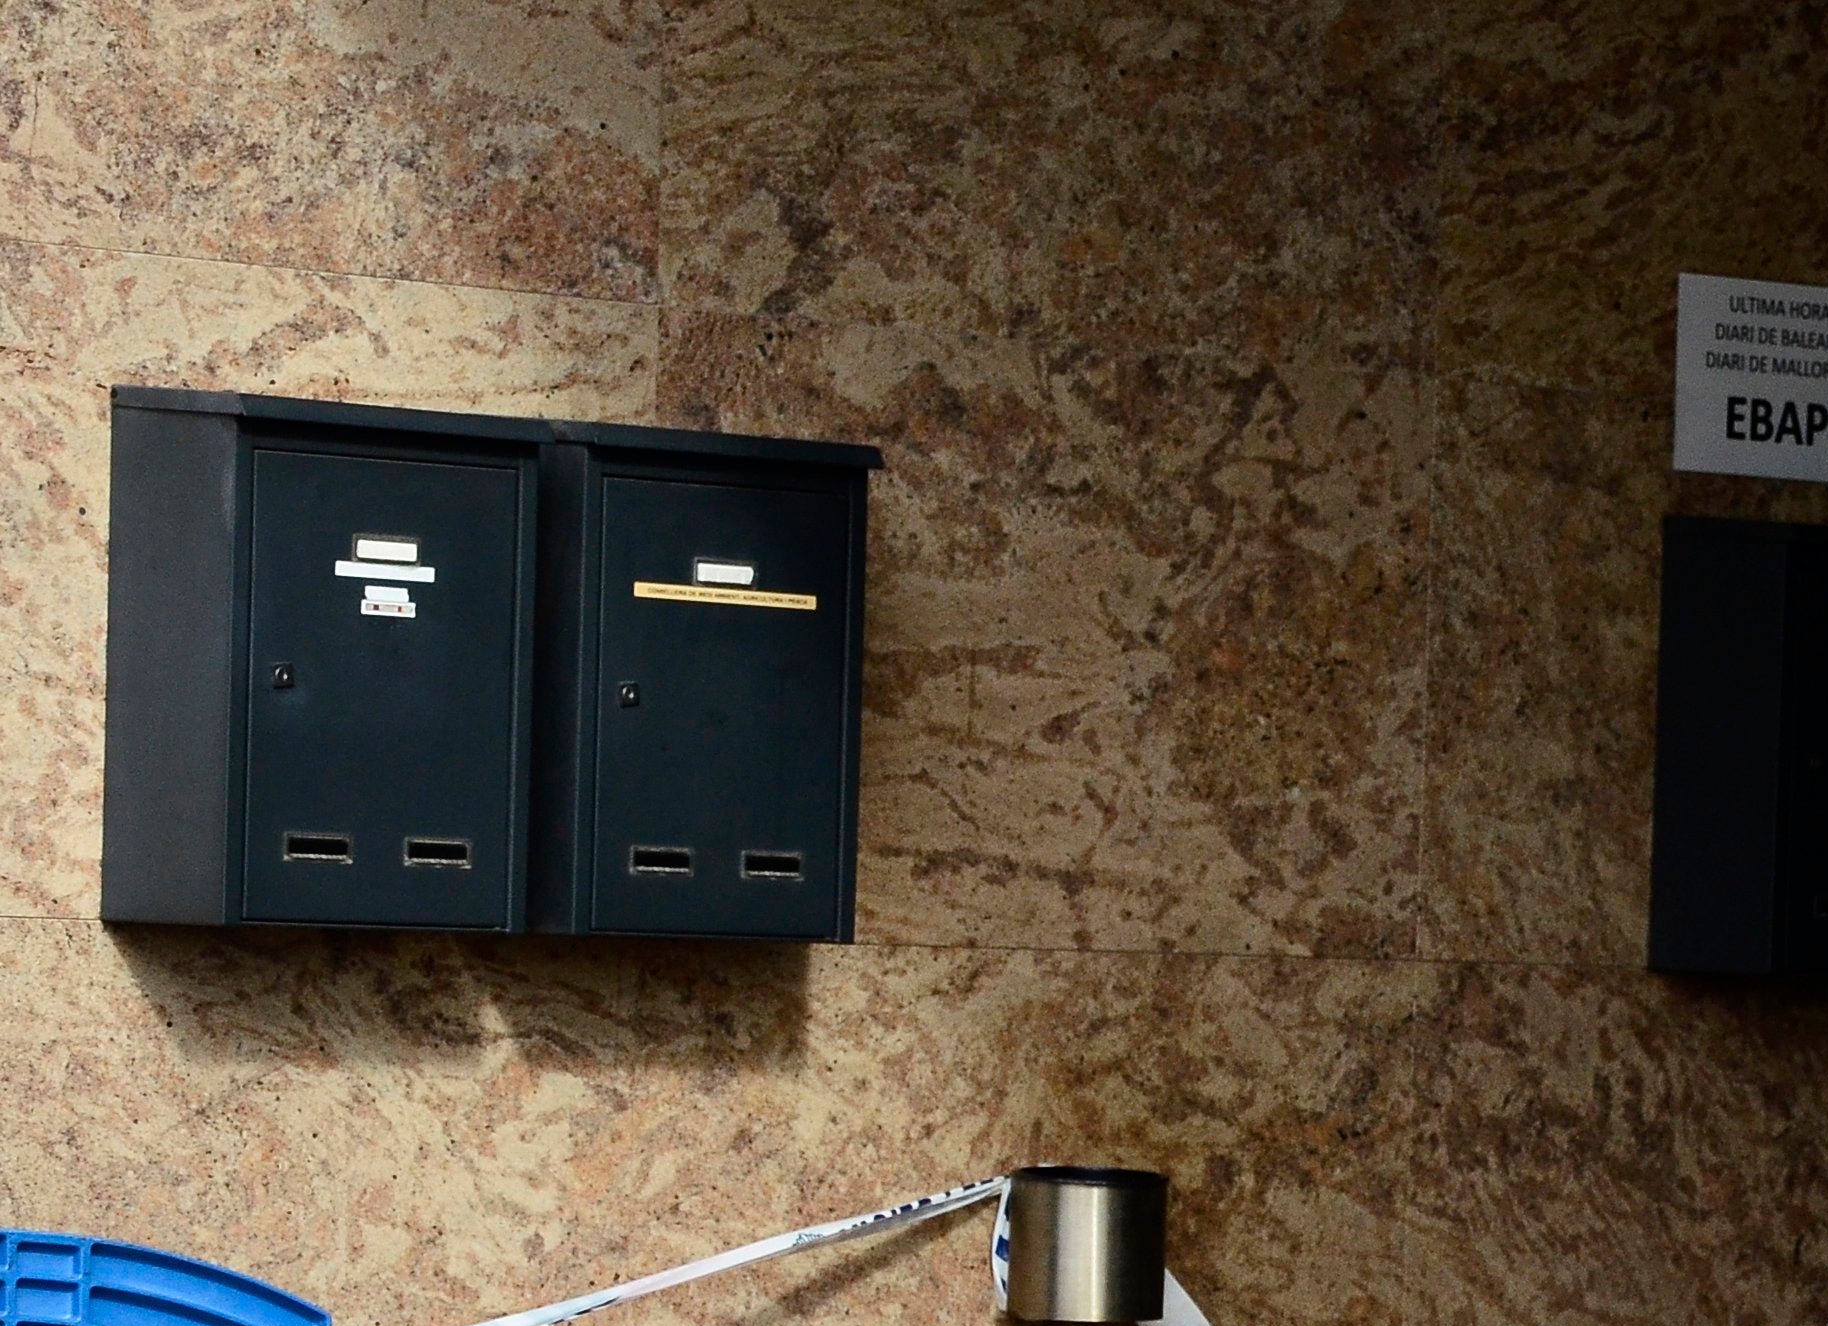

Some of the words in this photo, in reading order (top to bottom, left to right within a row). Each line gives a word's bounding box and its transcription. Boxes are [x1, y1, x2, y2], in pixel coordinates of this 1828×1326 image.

[1729, 295, 1785, 317] ULTIMA
[1715, 323, 1754, 343] DIARI
[1758, 327, 1777, 346] DE
[1706, 352, 1744, 370] DIARI
[1749, 356, 1768, 373] DE
